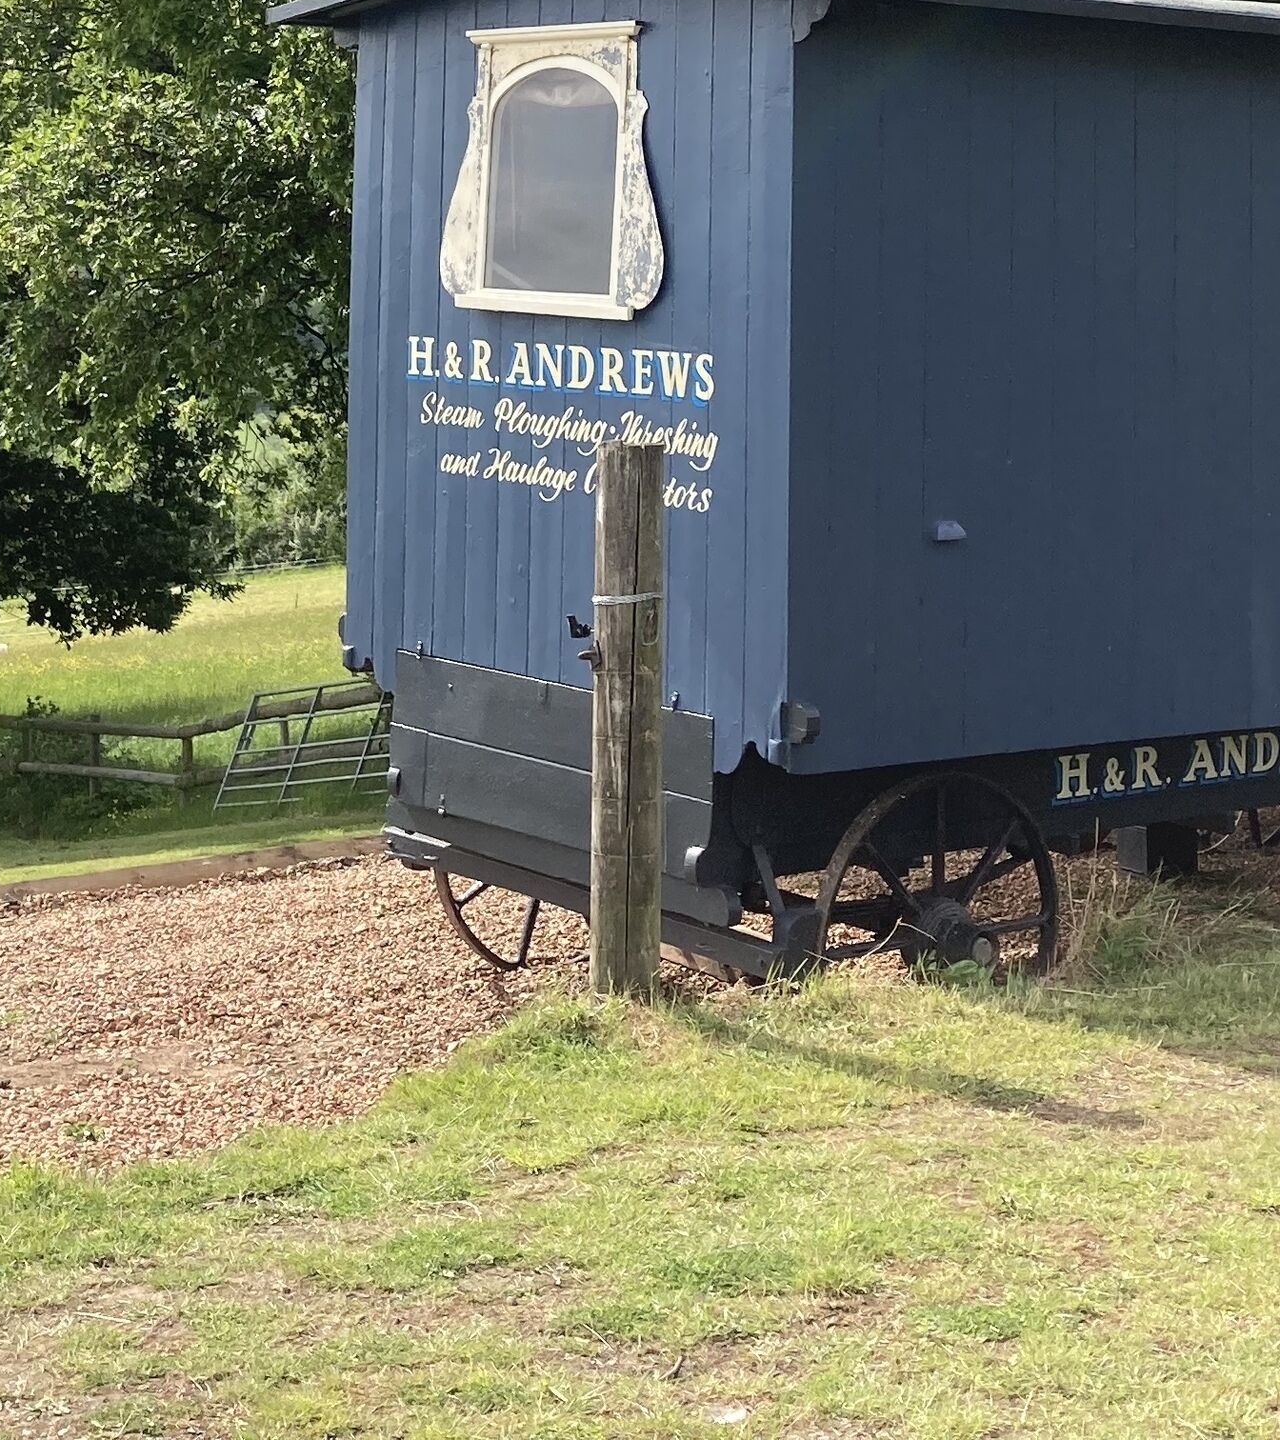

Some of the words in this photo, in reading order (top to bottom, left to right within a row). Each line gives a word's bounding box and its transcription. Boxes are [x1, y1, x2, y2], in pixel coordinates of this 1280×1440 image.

[505, 342, 715, 403] ANDREWS
[420, 391, 486, 429] Steam
[440, 451, 481, 478] and
[483, 447, 578, 502] Haulage
